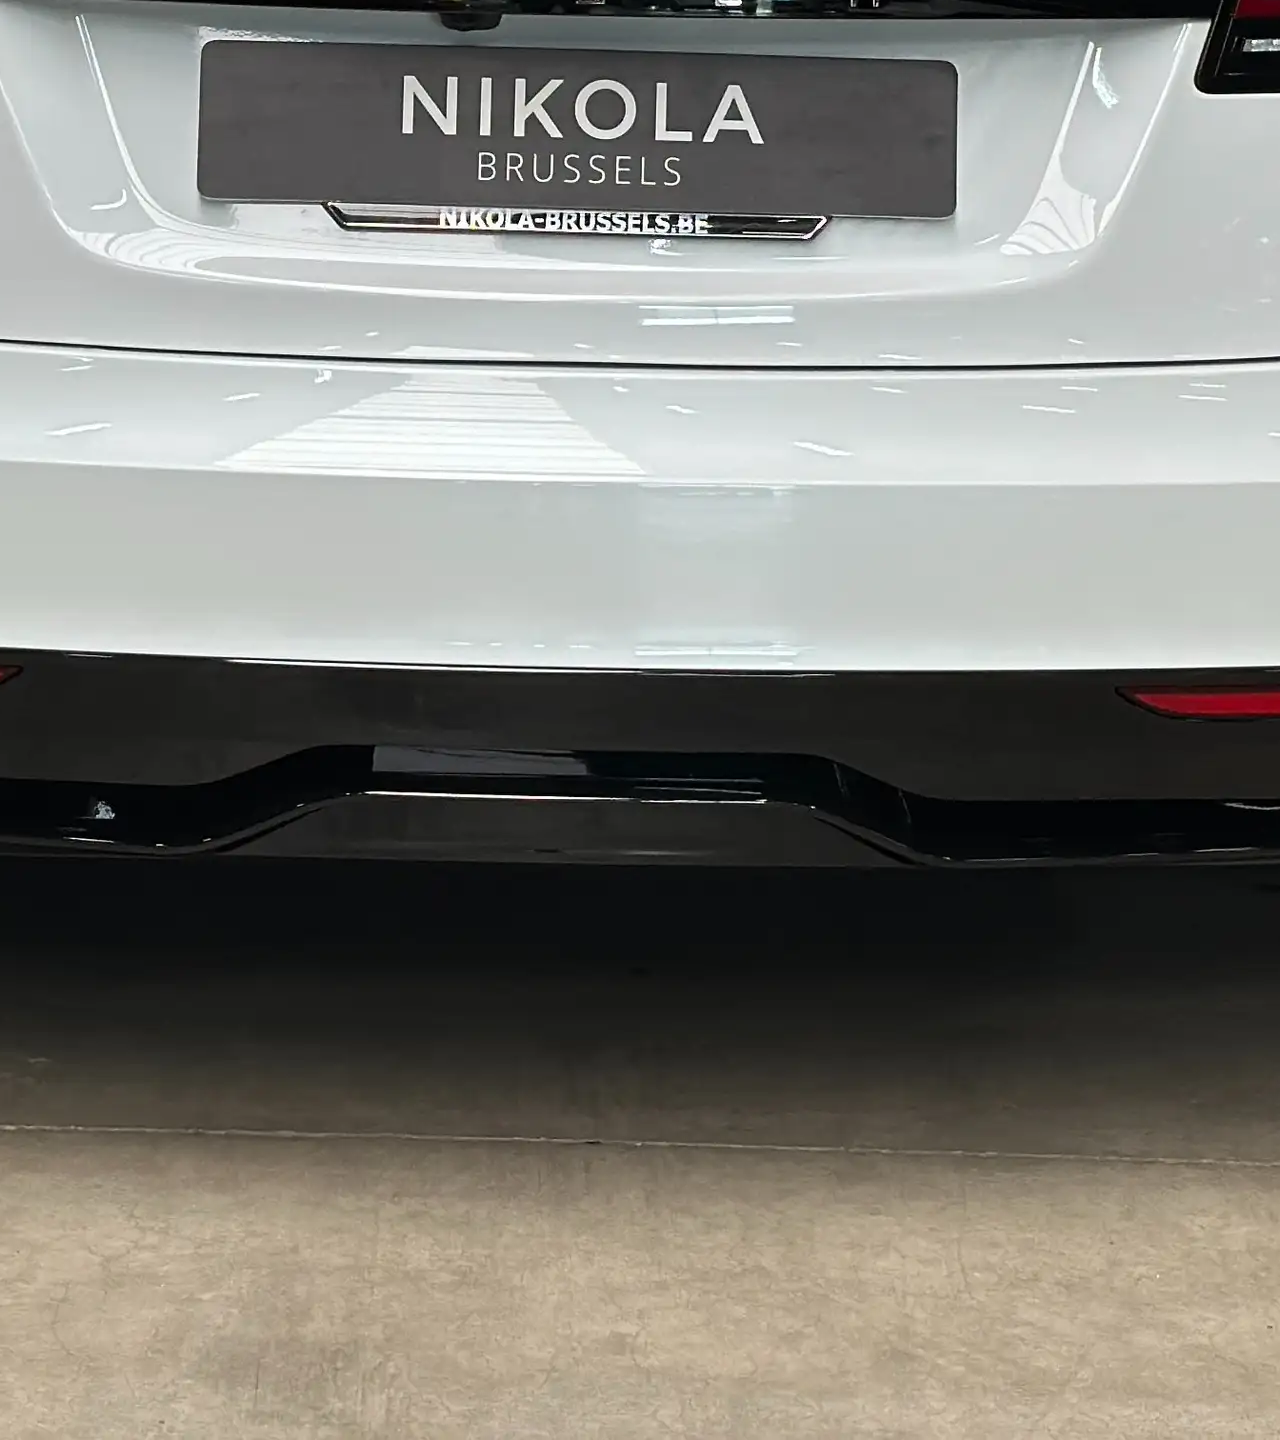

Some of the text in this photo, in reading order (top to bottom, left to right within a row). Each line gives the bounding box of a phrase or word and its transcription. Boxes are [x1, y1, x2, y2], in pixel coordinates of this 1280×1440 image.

[401, 75, 765, 145] NIKOLA
[477, 151, 682, 187] BRUSSELS
[439, 208, 709, 234] NIKOLA-BRUSSELS.BE
